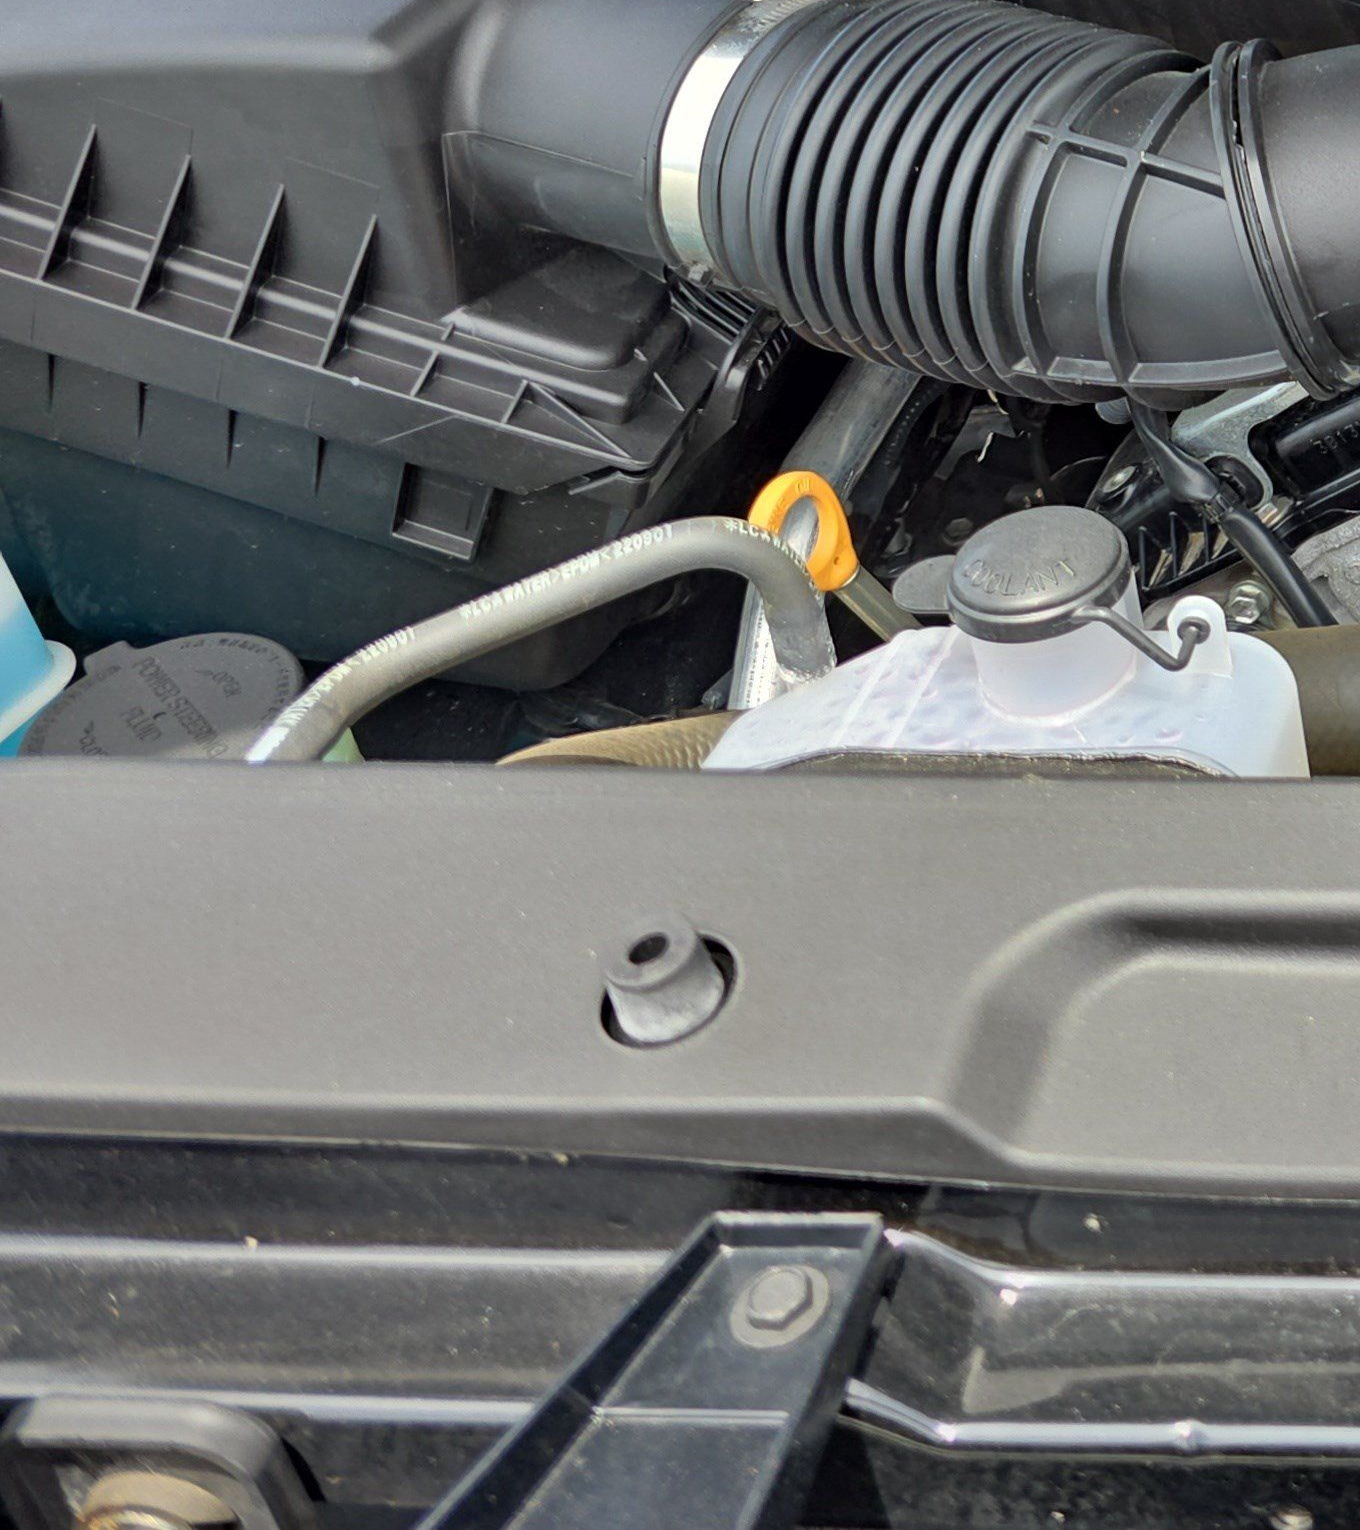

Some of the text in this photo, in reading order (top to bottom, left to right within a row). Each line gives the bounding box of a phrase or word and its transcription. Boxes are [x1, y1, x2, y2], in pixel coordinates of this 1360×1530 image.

[963, 558, 1077, 598] COOLANT
[211, 670, 244, 698] OPEN
[120, 705, 164, 742] FLUID
[133, 655, 229, 758] POWER STEERING
